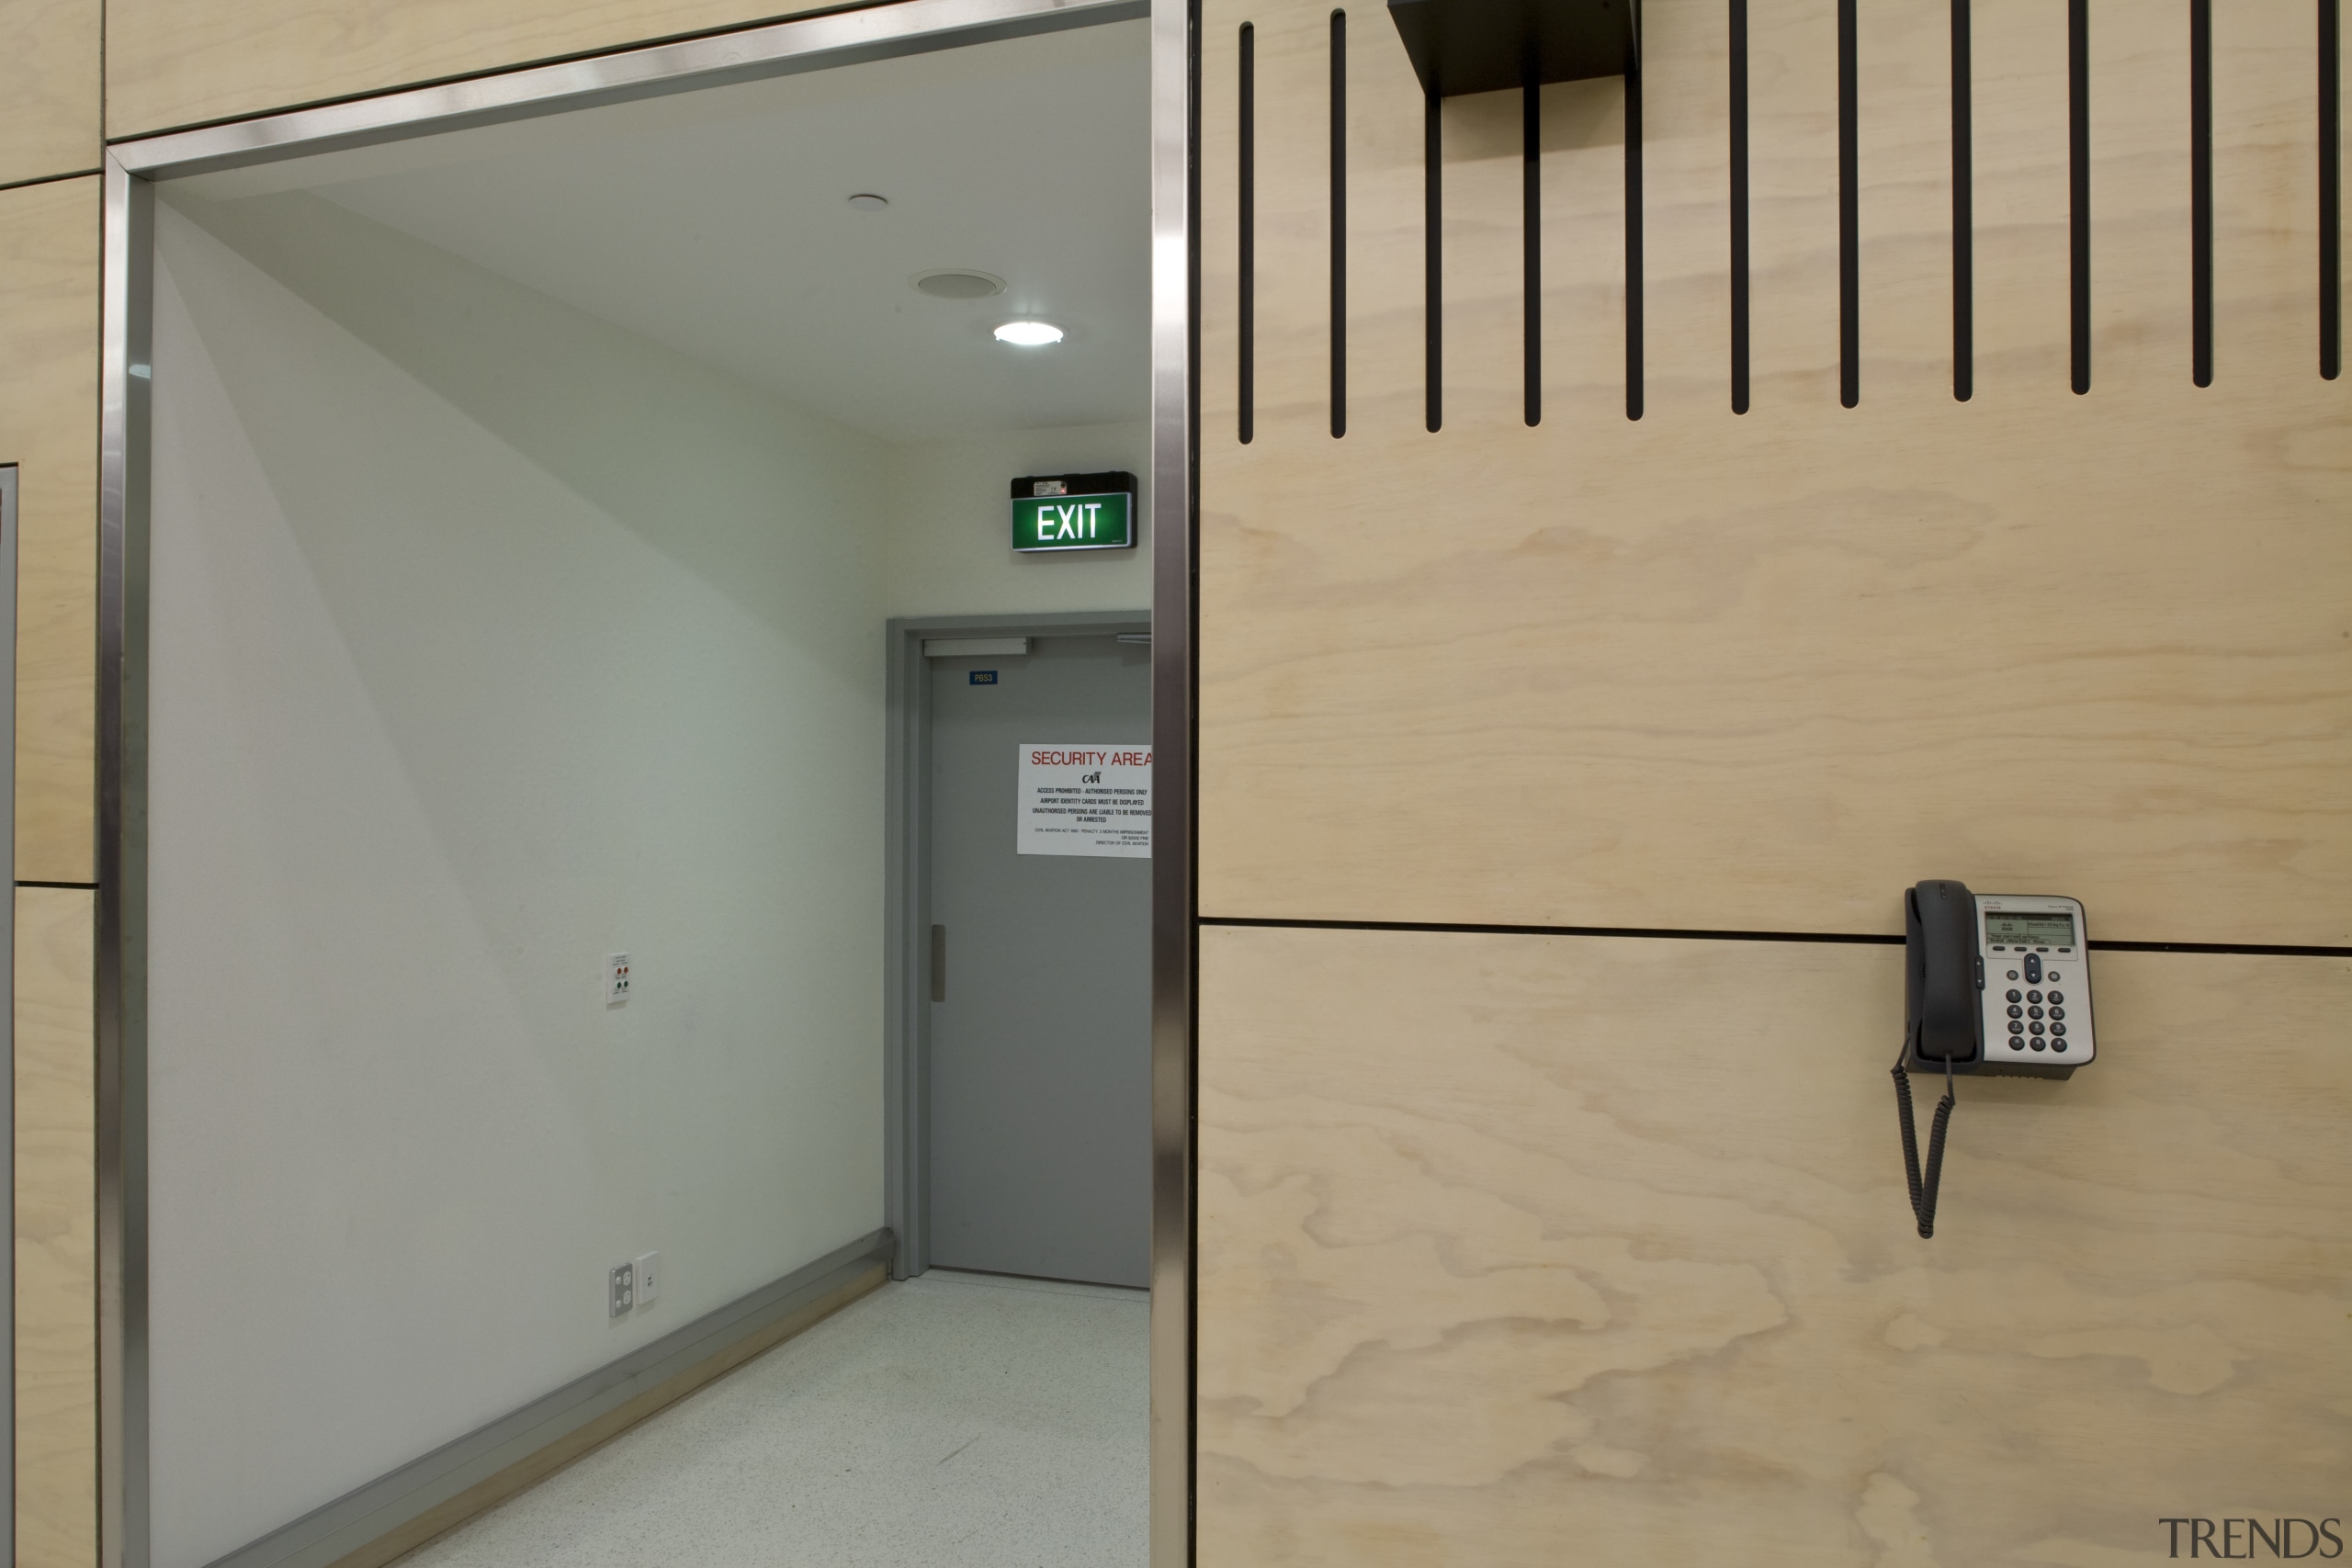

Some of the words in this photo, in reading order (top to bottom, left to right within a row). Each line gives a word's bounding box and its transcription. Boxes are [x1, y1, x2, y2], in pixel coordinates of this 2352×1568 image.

[1037, 503, 1102, 540] EXIT
[1031, 751, 1107, 765] SECURITY
[1111, 752, 1152, 766] AREA
[1082, 772, 1102, 784] CAA
